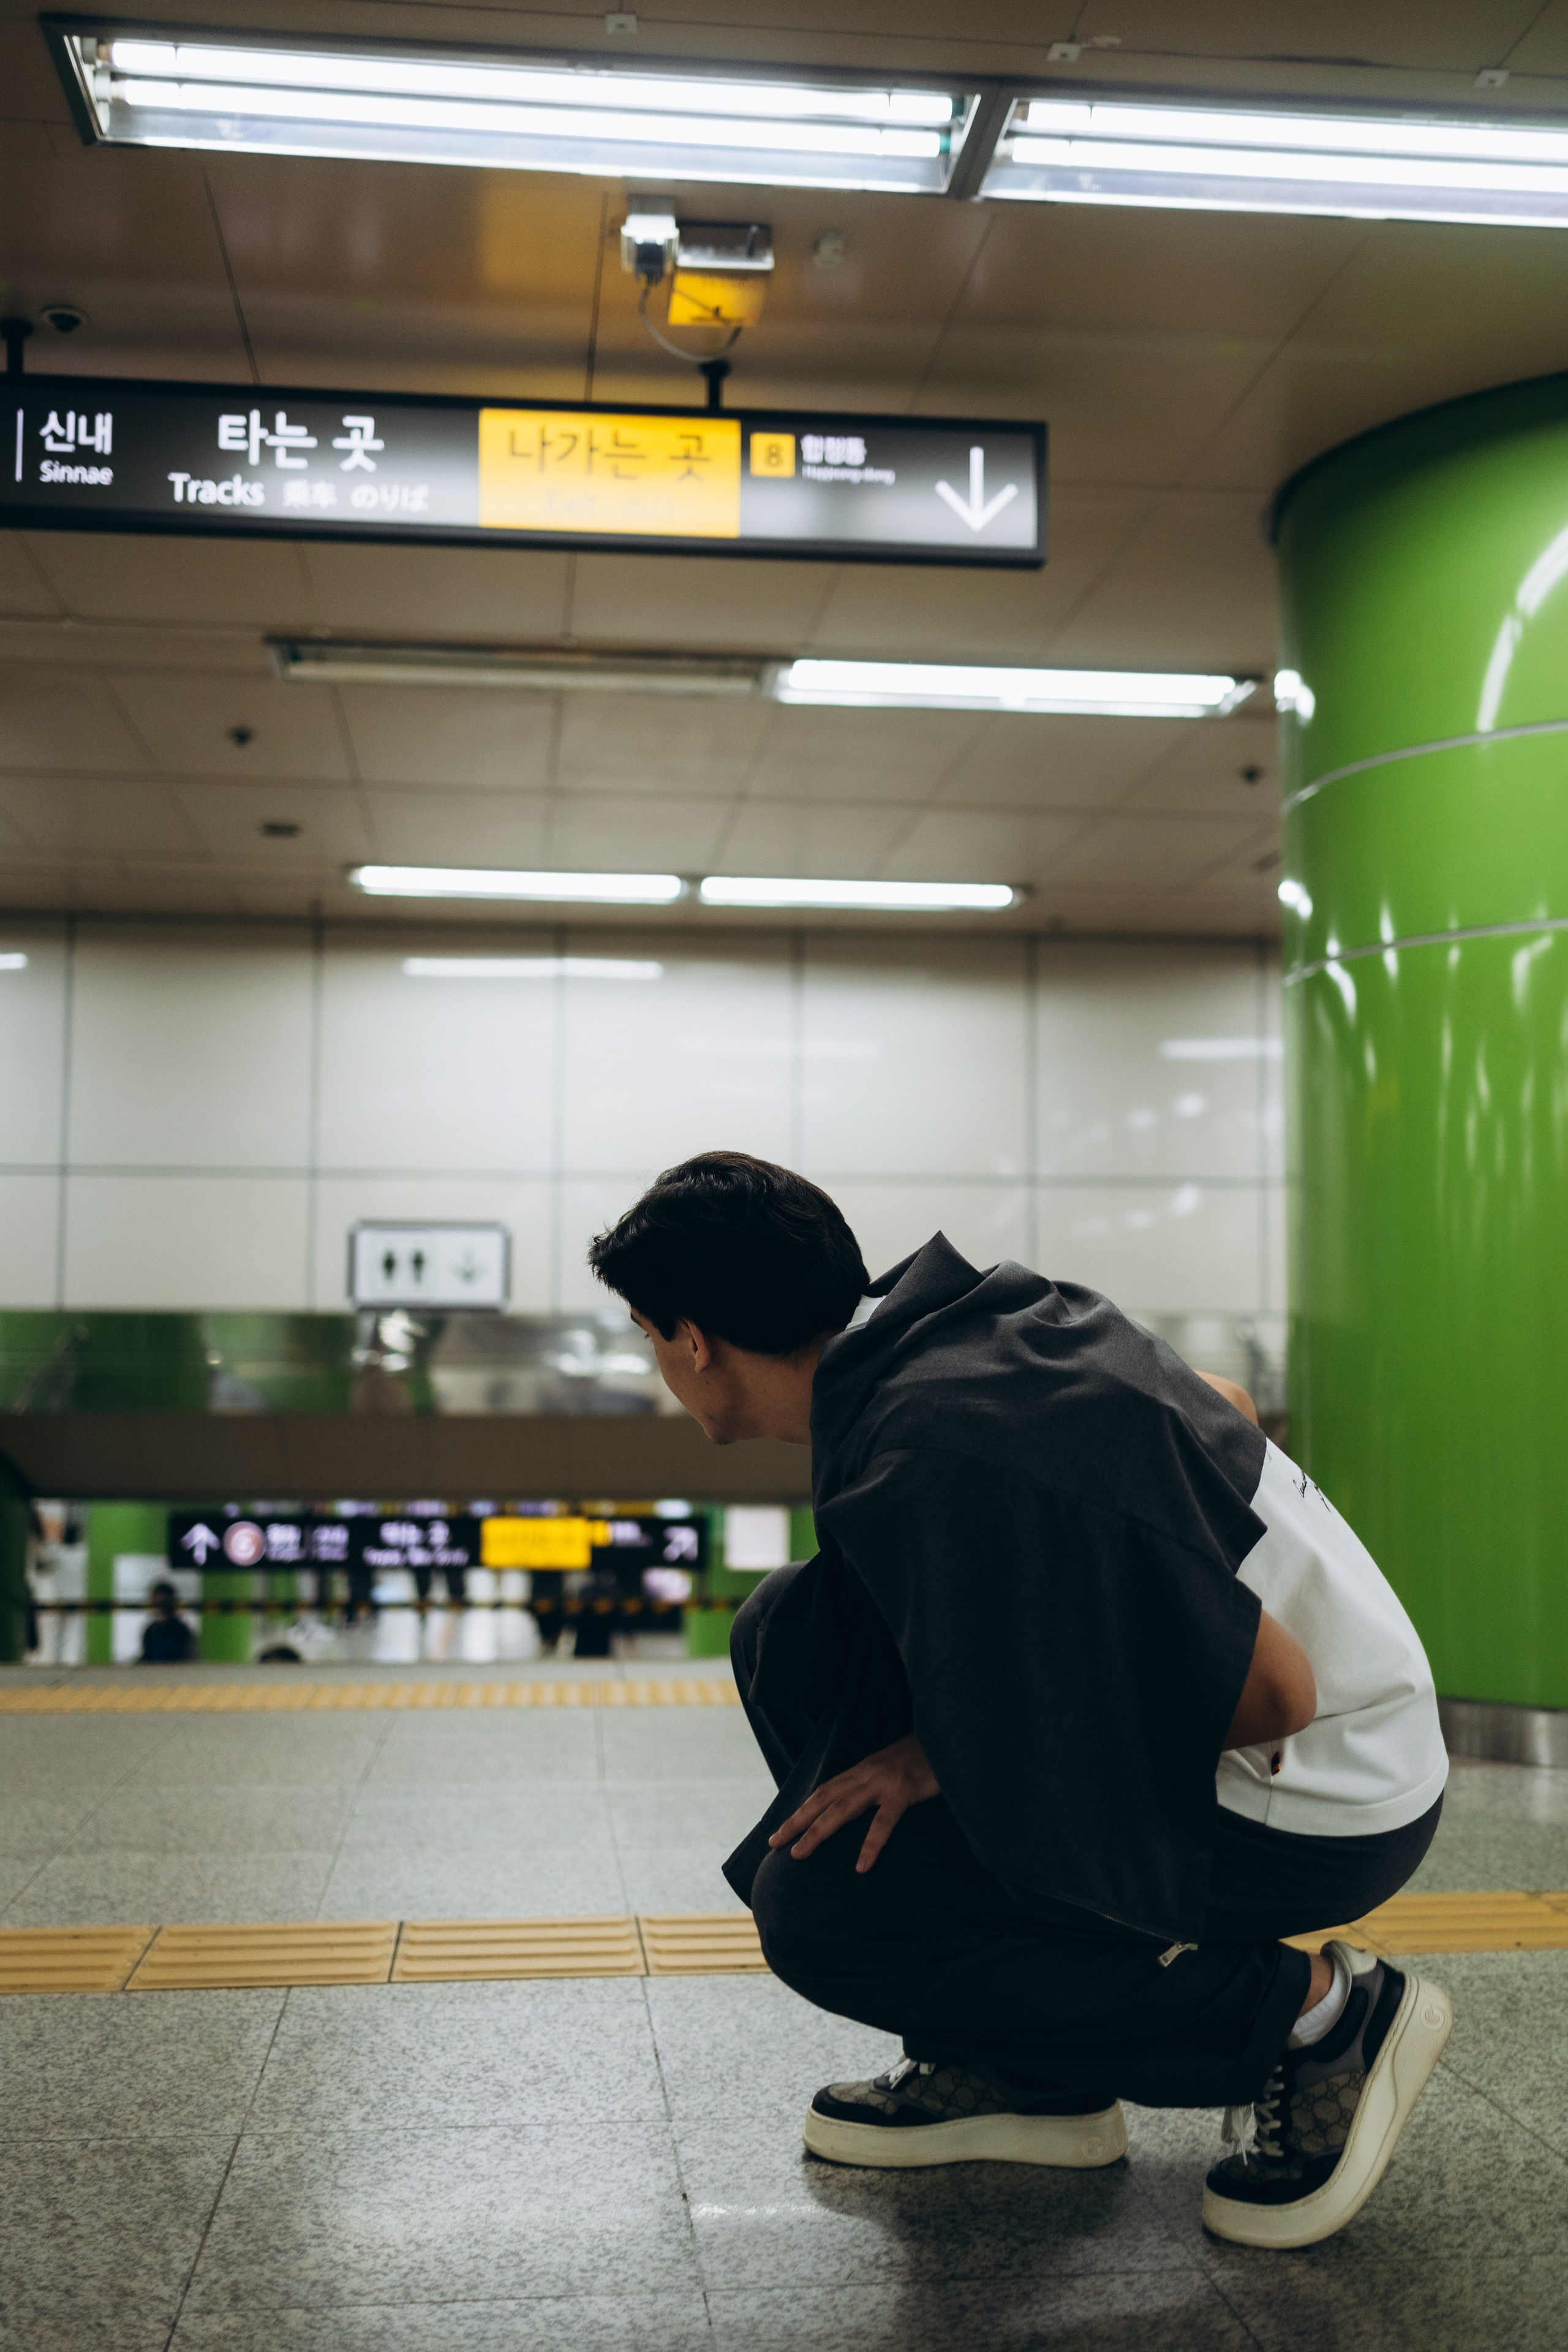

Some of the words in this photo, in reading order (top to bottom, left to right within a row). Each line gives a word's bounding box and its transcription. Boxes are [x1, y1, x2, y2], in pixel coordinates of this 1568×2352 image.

[39, 409, 113, 455] 신내
[217, 409, 318, 470] 타는
[331, 415, 385, 473] 곳
[39, 460, 114, 486] Sinnae
[508, 425, 647, 480] 나가는
[669, 433, 711, 483] 곳
[767, 443, 782, 466] 8
[167, 472, 266, 506] Tracks
